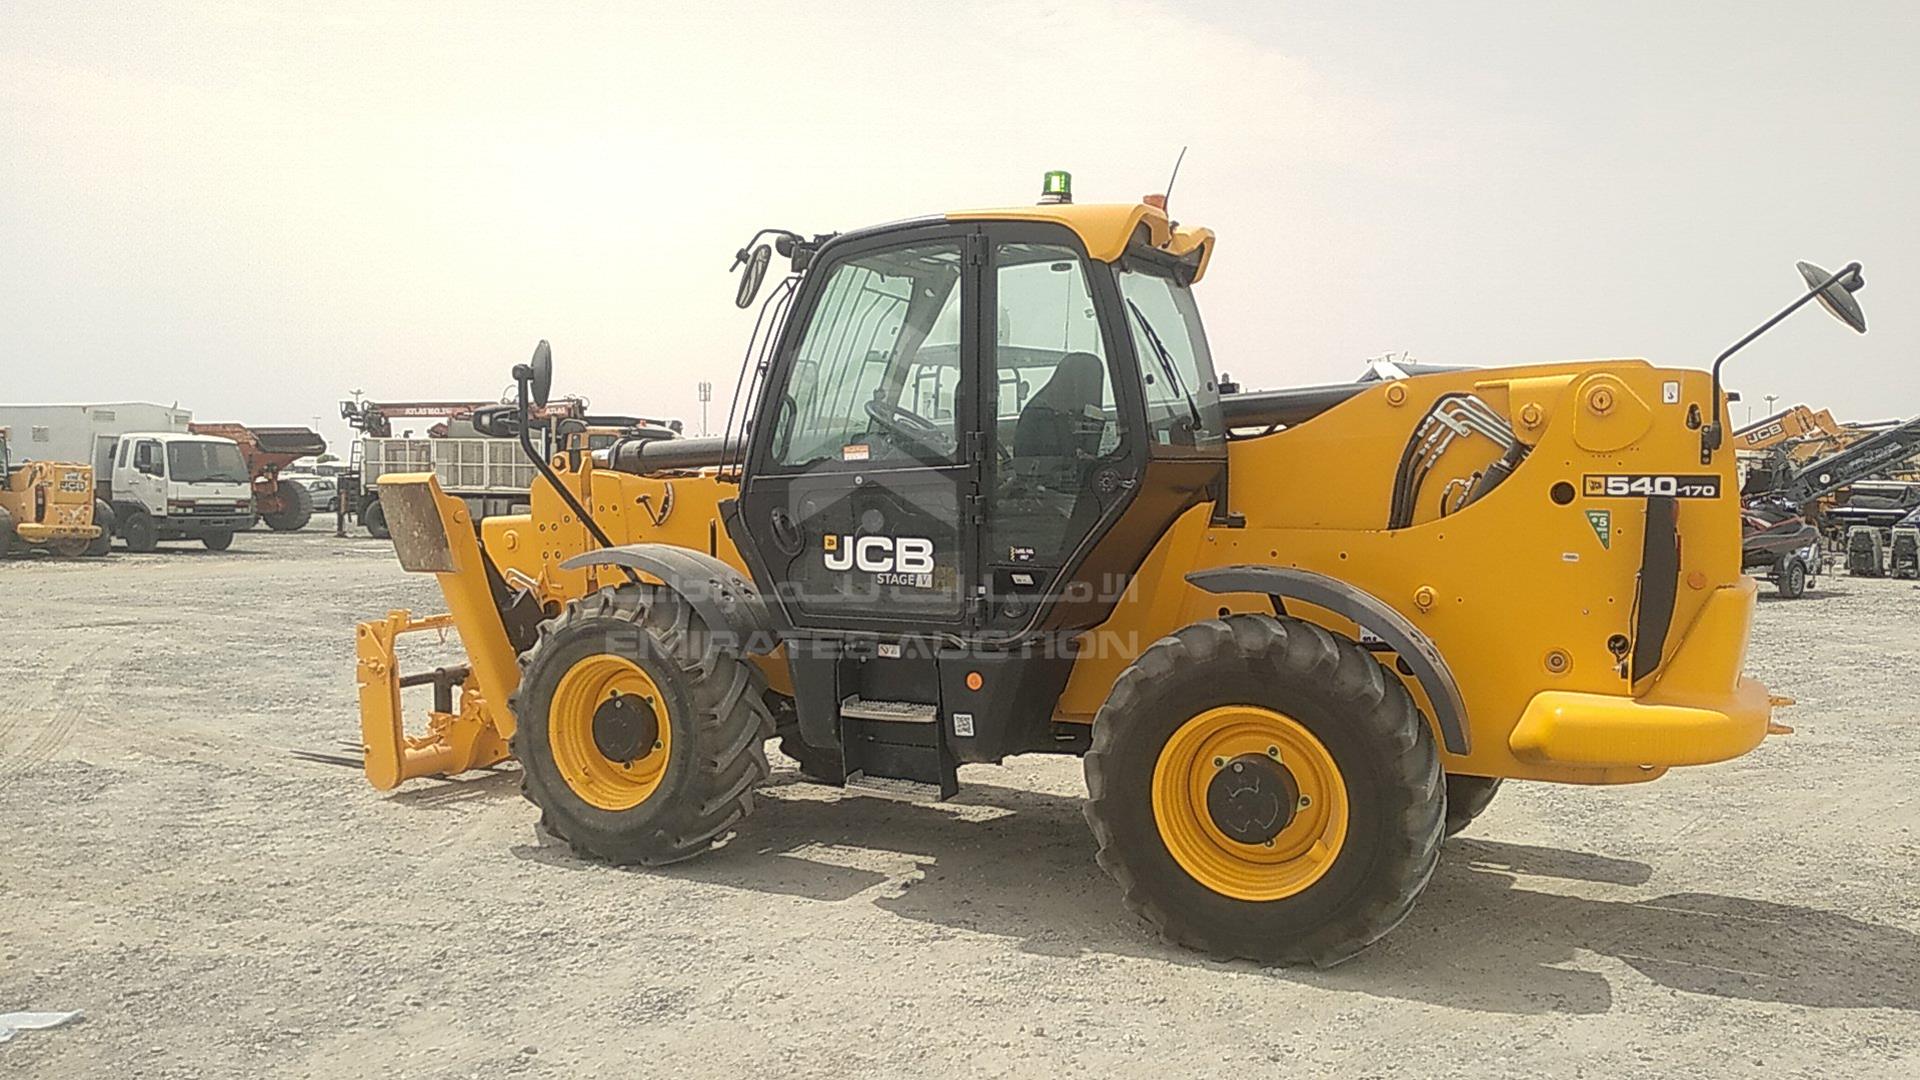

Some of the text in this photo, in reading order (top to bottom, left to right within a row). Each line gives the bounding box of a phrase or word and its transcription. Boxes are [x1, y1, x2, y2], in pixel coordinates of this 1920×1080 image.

[1747, 423, 1783, 444] JCB
[824, 535, 934, 573] JCB
[876, 573, 914, 585] STAGE
